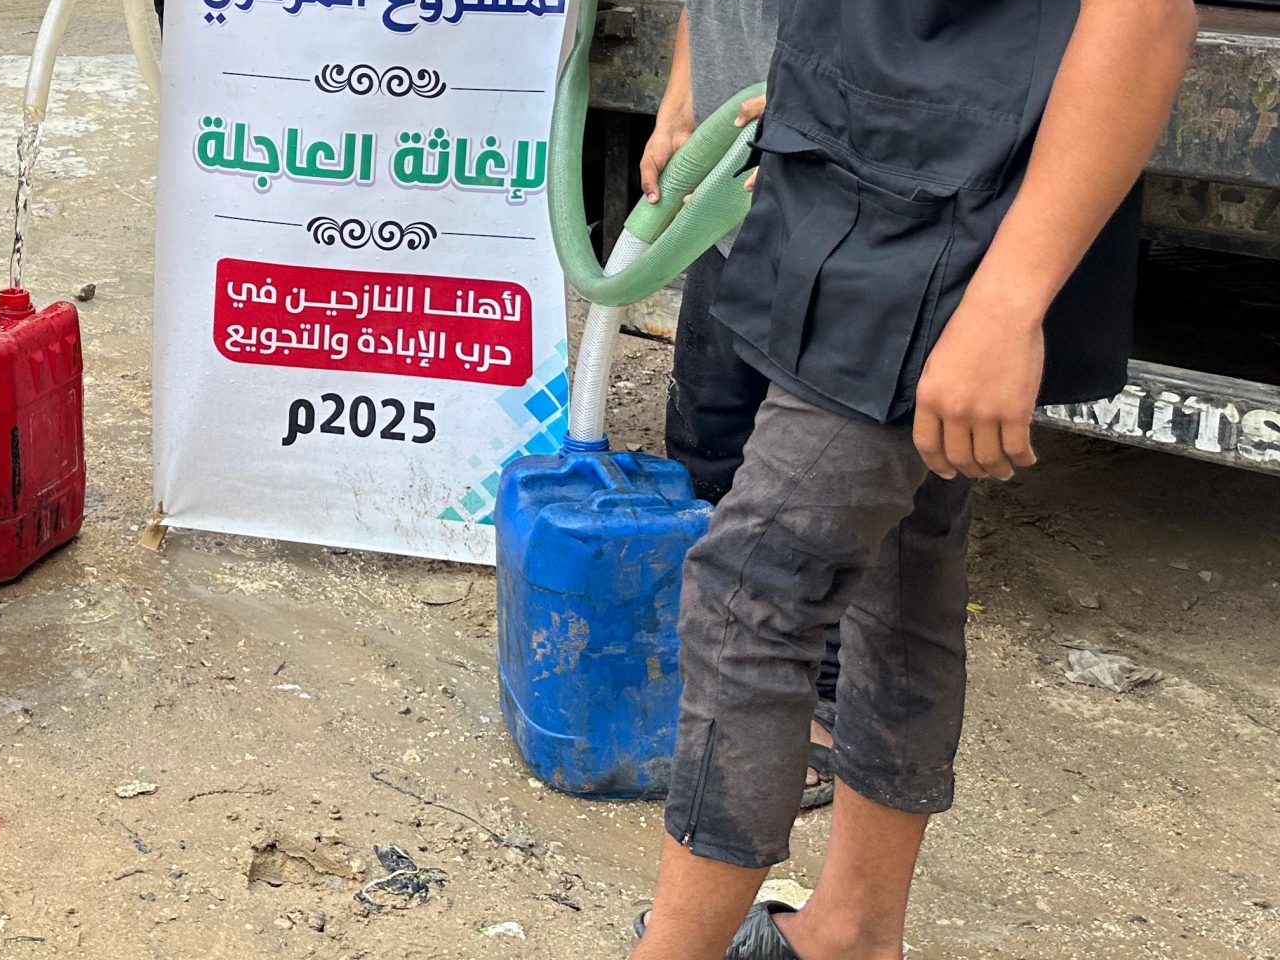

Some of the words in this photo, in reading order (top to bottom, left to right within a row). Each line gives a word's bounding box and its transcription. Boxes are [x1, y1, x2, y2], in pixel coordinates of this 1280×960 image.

[197, 116, 373, 189] العاجلة
[394, 127, 547, 200] لإغاثة
[226, 277, 278, 308] في
[284, 284, 414, 319] النازحين
[423, 288, 522, 322] لأهلنا
[224, 322, 349, 360] والتجويع
[356, 326, 446, 368] الإبادة
[454, 339, 512, 372] حرب
